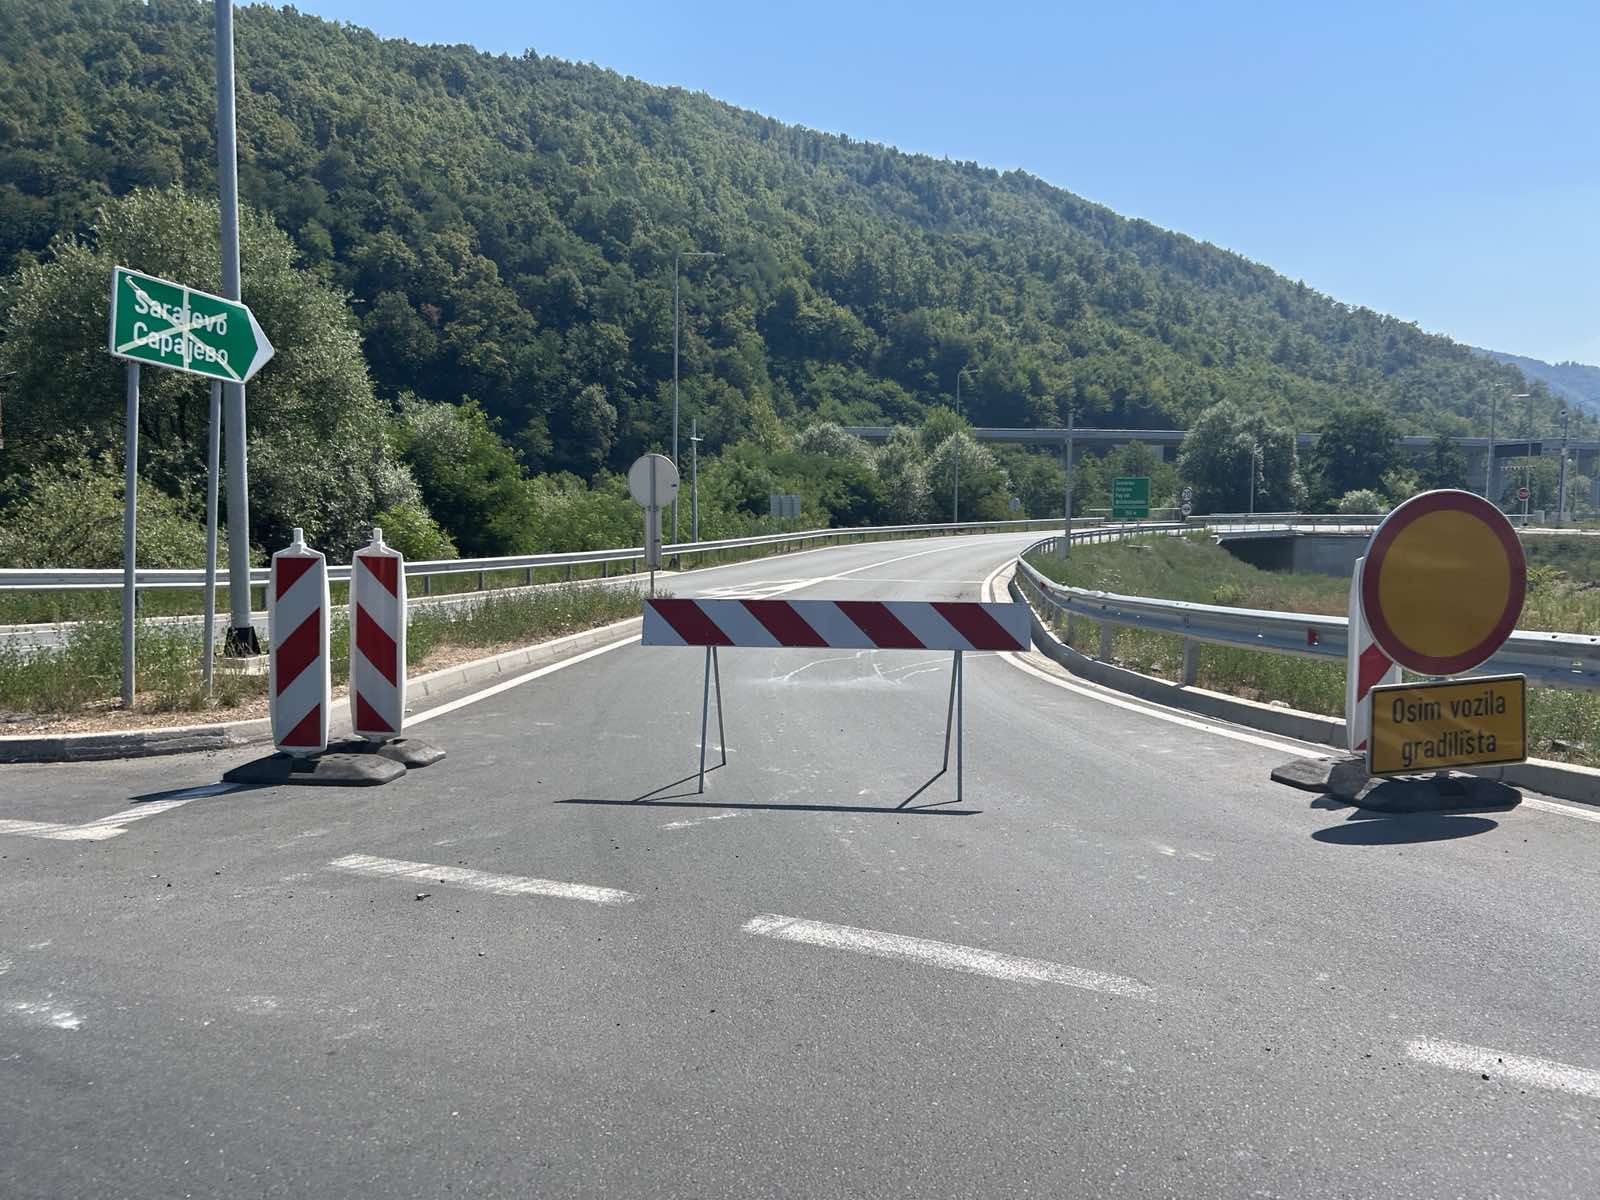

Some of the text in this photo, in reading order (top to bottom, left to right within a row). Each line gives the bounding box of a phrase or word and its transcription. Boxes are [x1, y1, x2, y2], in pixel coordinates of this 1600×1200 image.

[134, 289, 228, 336] Sarajevo
[1392, 690, 1506, 724] Osim vozila
[1402, 730, 1497, 768] gradilišta
